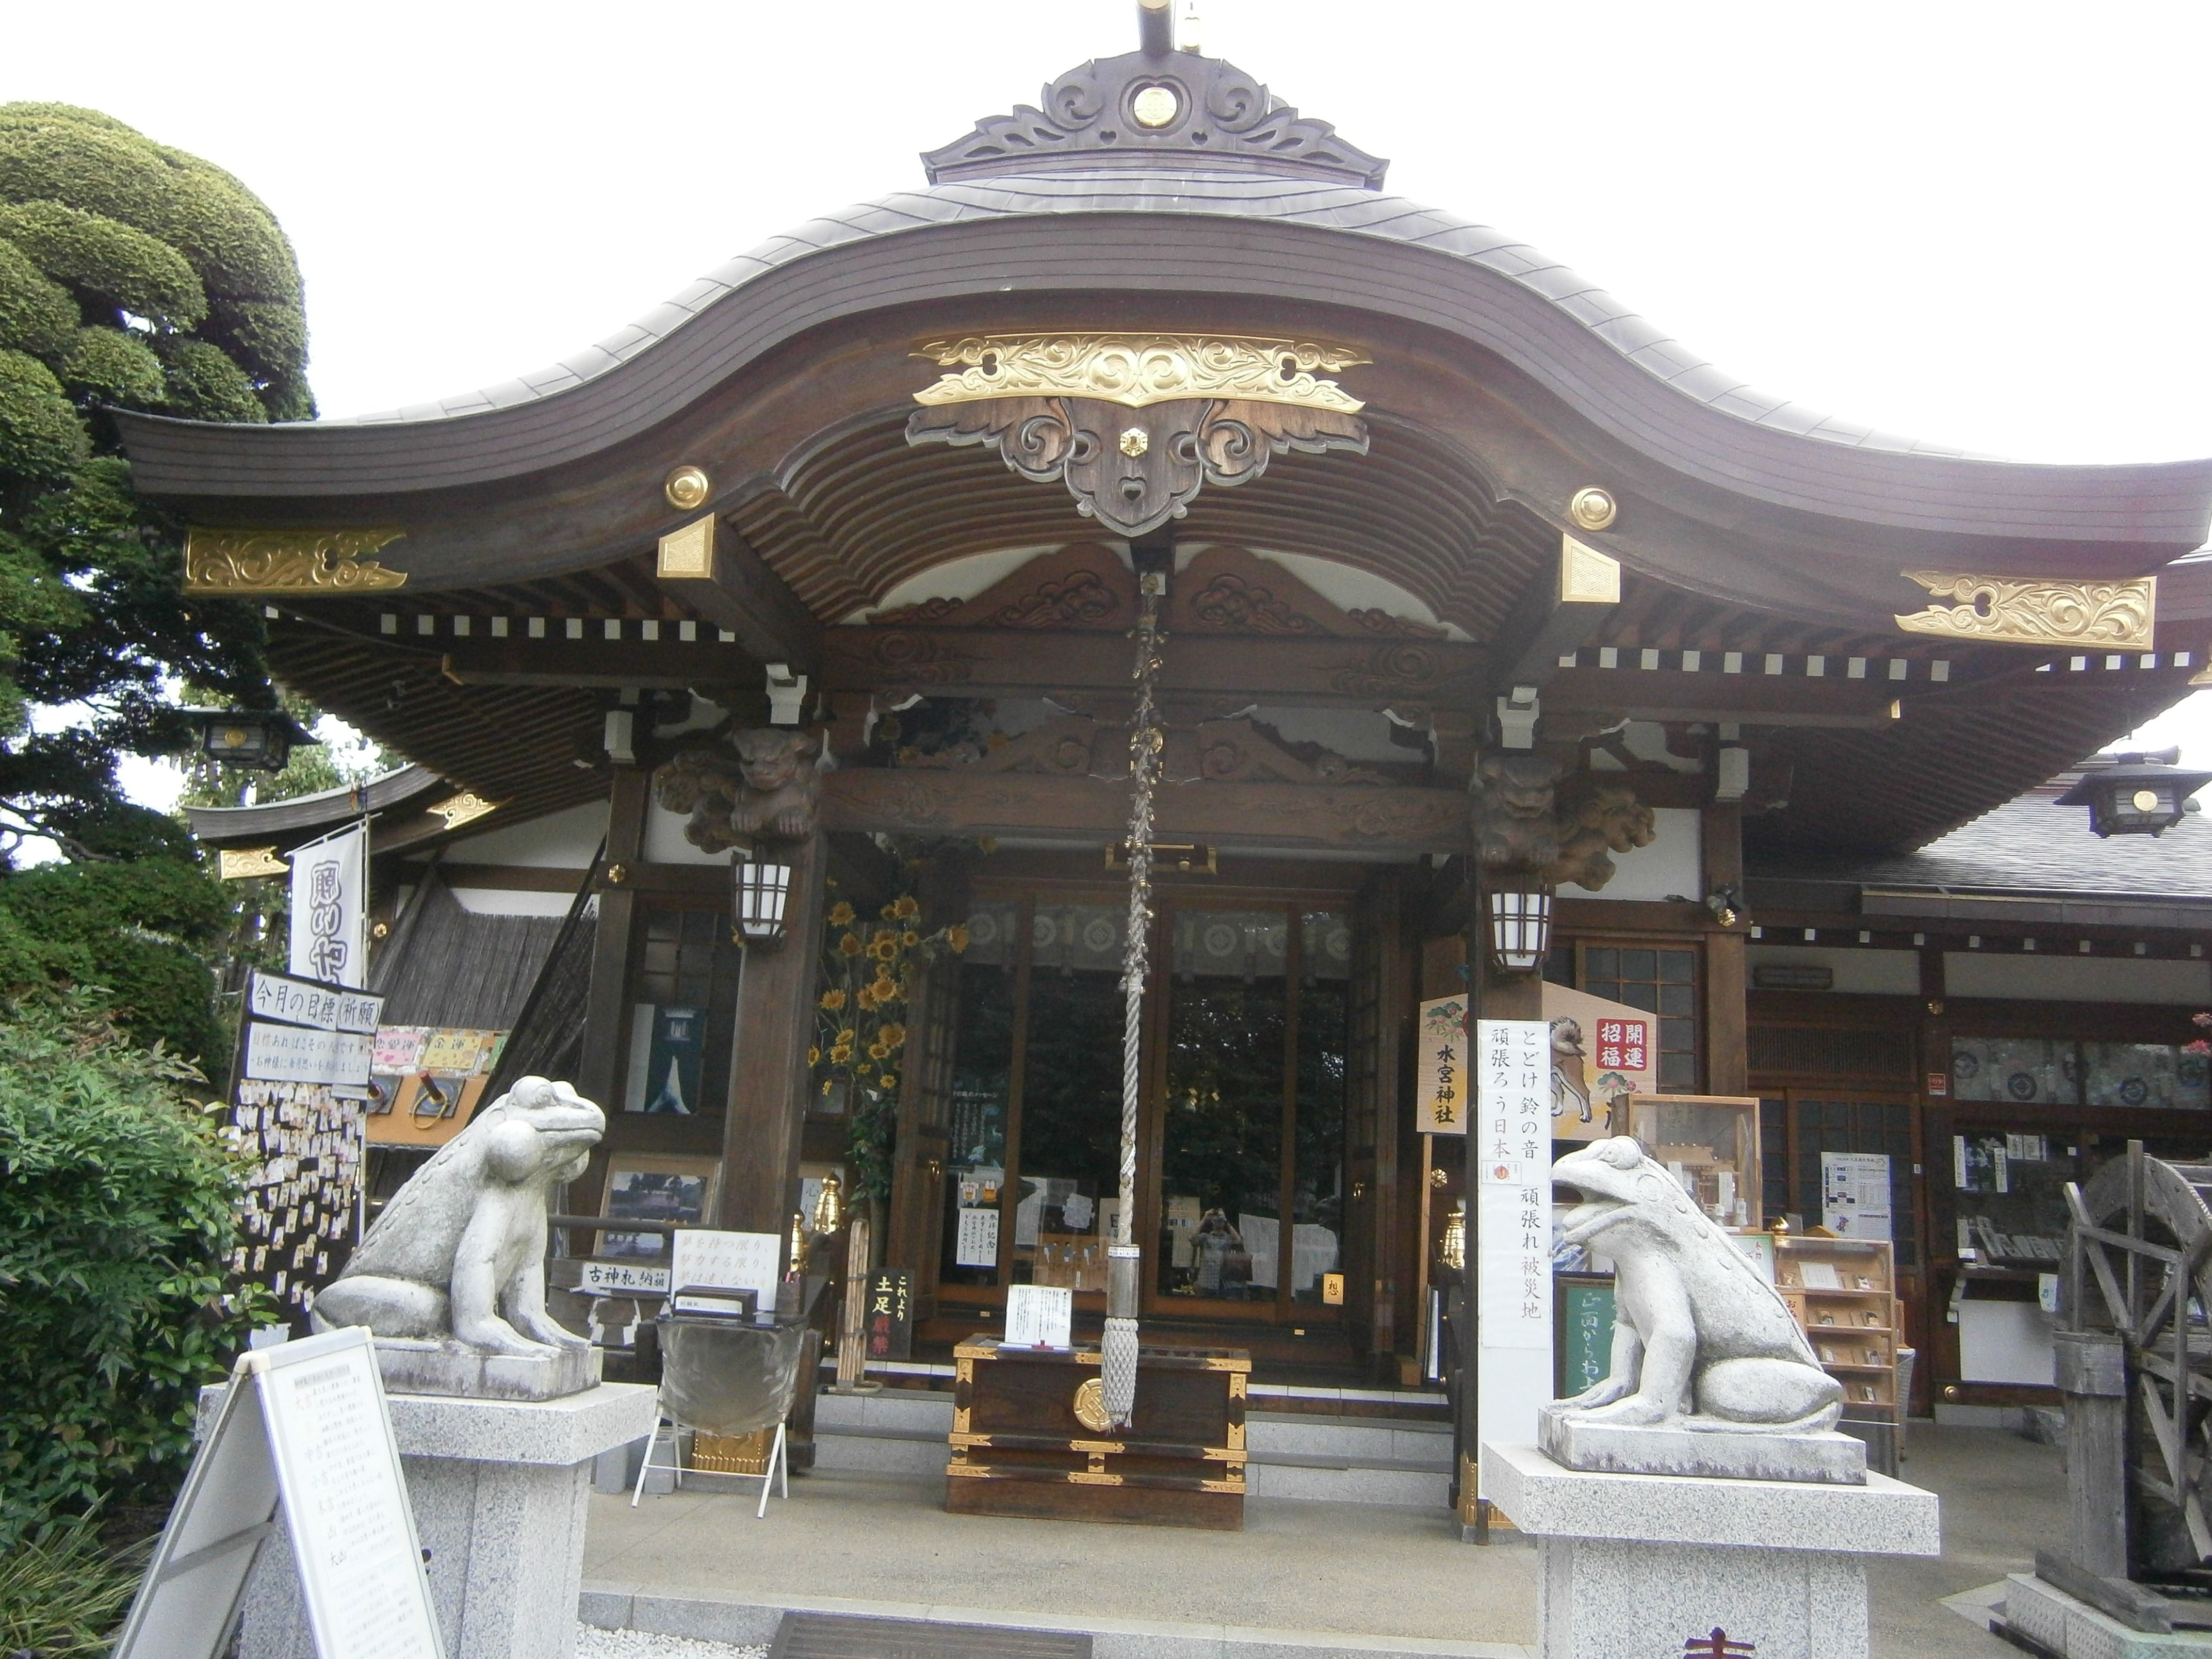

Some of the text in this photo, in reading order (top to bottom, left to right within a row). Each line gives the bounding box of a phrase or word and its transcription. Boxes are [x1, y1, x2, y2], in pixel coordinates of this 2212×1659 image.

[310, 860, 347, 985] 願い叶
[1435, 1045, 1456, 1124] 水宮神社
[1624, 1024, 1644, 1068] 開運
[1491, 1028, 1510, 1158] 頑張ろう日本
[1520, 1031, 1541, 1319] とどけ鈴の音 頑張れ被災地
[872, 1276, 893, 1354] 土足厳禁
[897, 1276, 907, 1322] これより
[1328, 1280, 1339, 1296] 想
